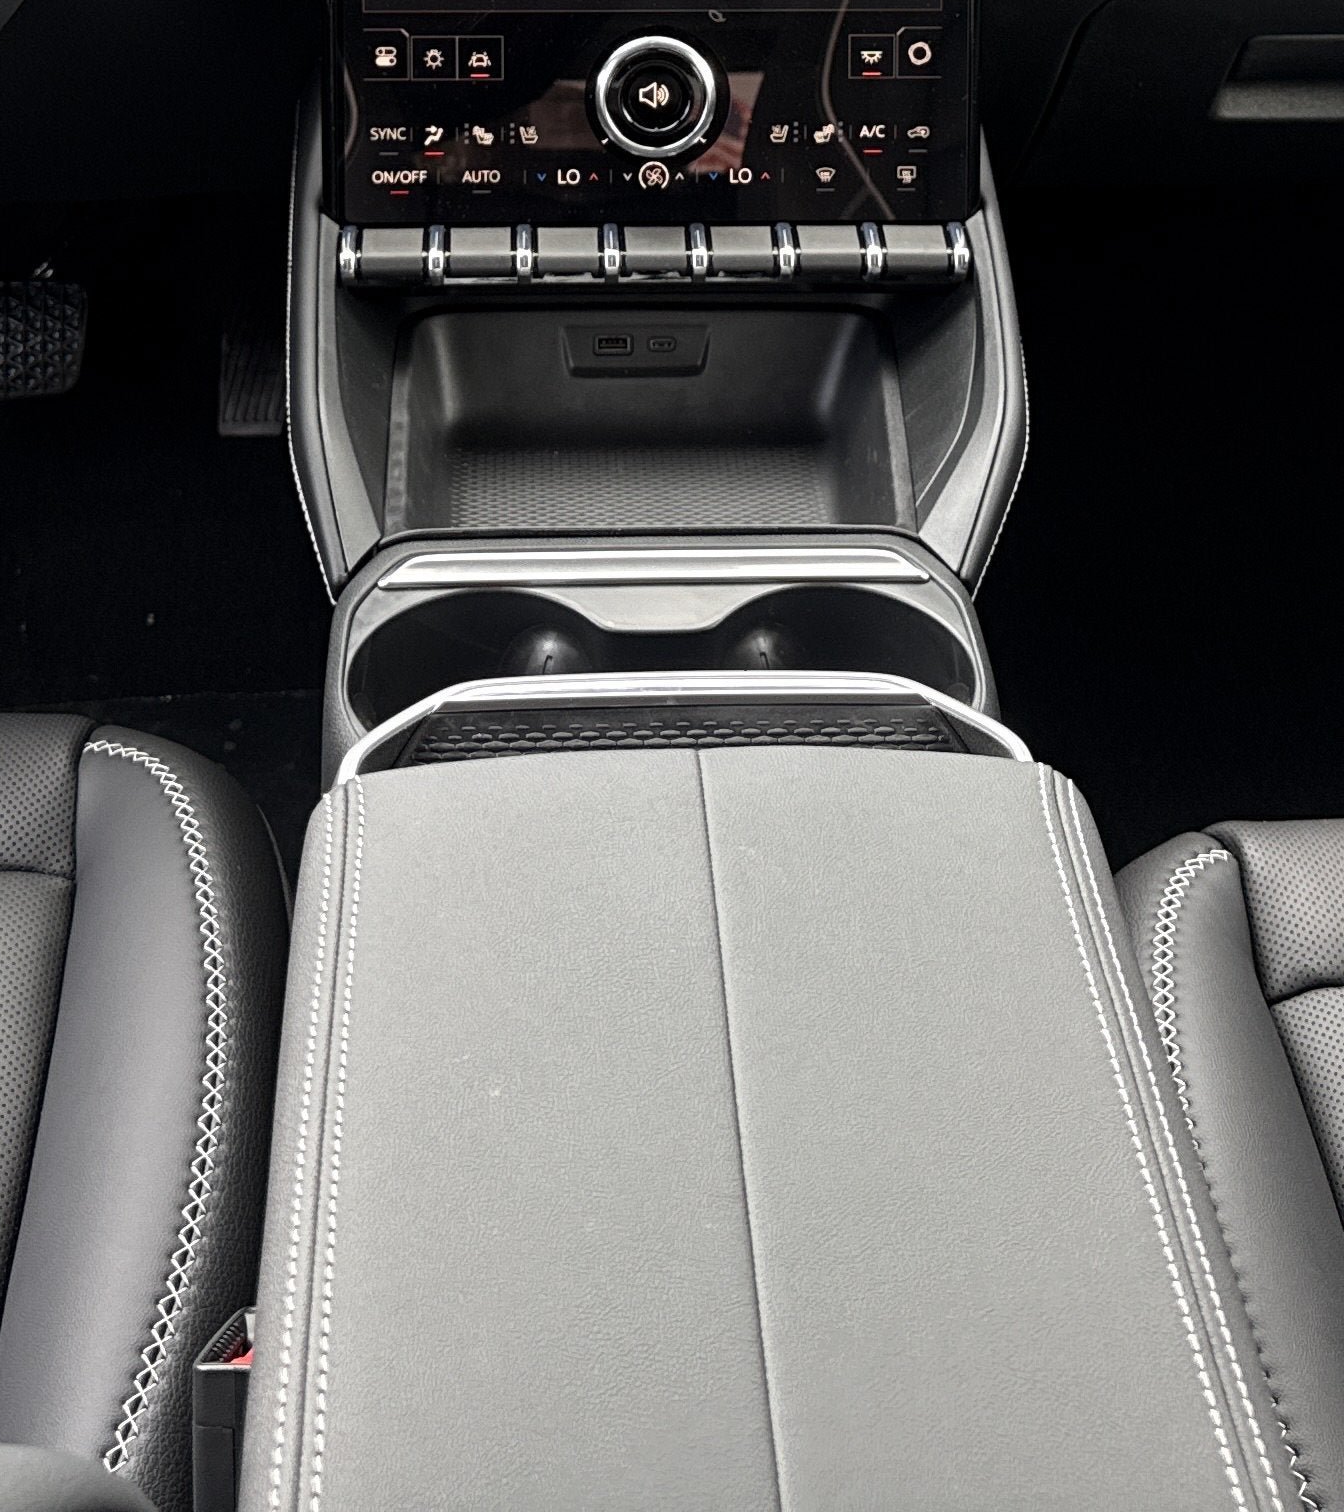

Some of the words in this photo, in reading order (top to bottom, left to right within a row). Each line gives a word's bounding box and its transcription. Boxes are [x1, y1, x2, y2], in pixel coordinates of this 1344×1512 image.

[370, 127, 406, 141] SYNC
[859, 125, 886, 138] A/C
[371, 170, 428, 184] ON/OFF
[462, 170, 501, 184] AUTO
[557, 169, 581, 185] LO
[729, 167, 752, 184] LO
